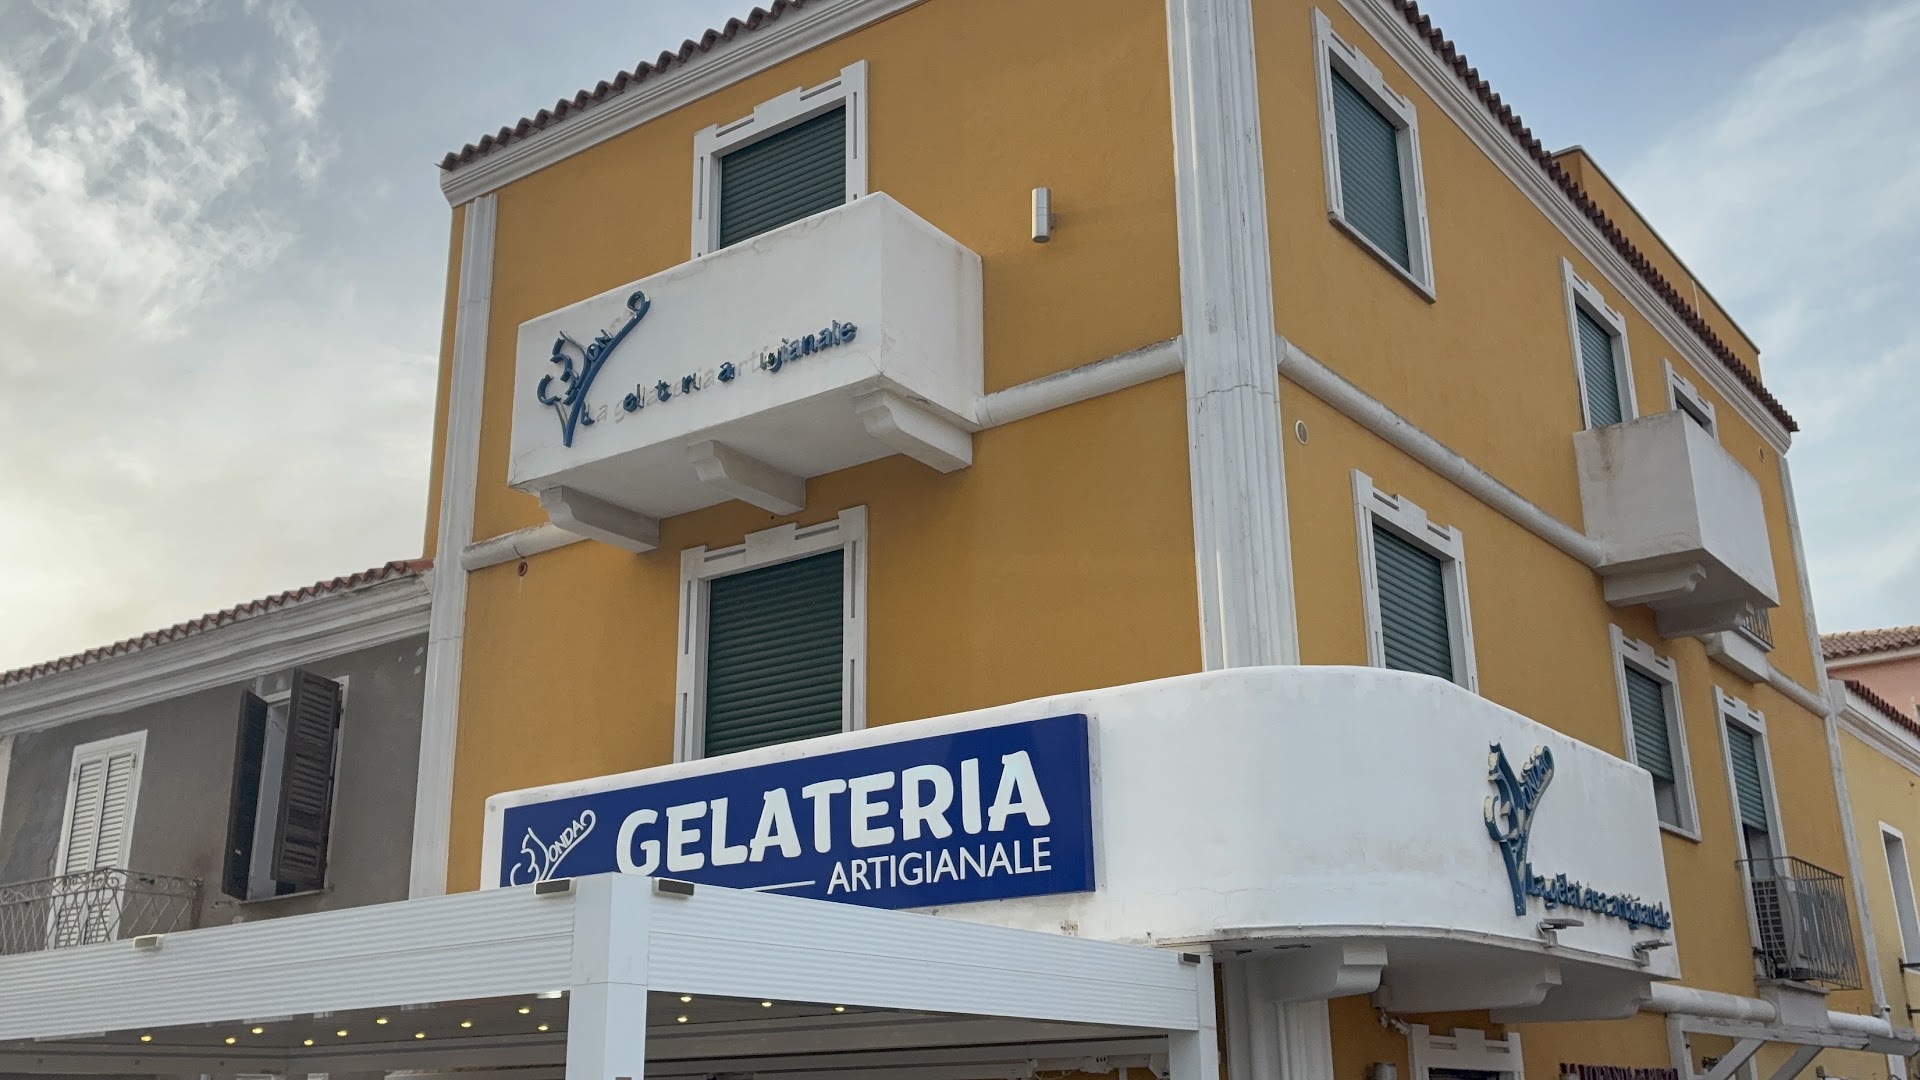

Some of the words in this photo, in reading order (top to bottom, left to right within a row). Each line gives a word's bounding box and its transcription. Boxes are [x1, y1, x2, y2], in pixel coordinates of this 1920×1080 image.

[549, 819, 584, 862] ONDA
[616, 749, 1051, 877] GELATERIA
[827, 837, 1052, 895] ARTIGIANALE
